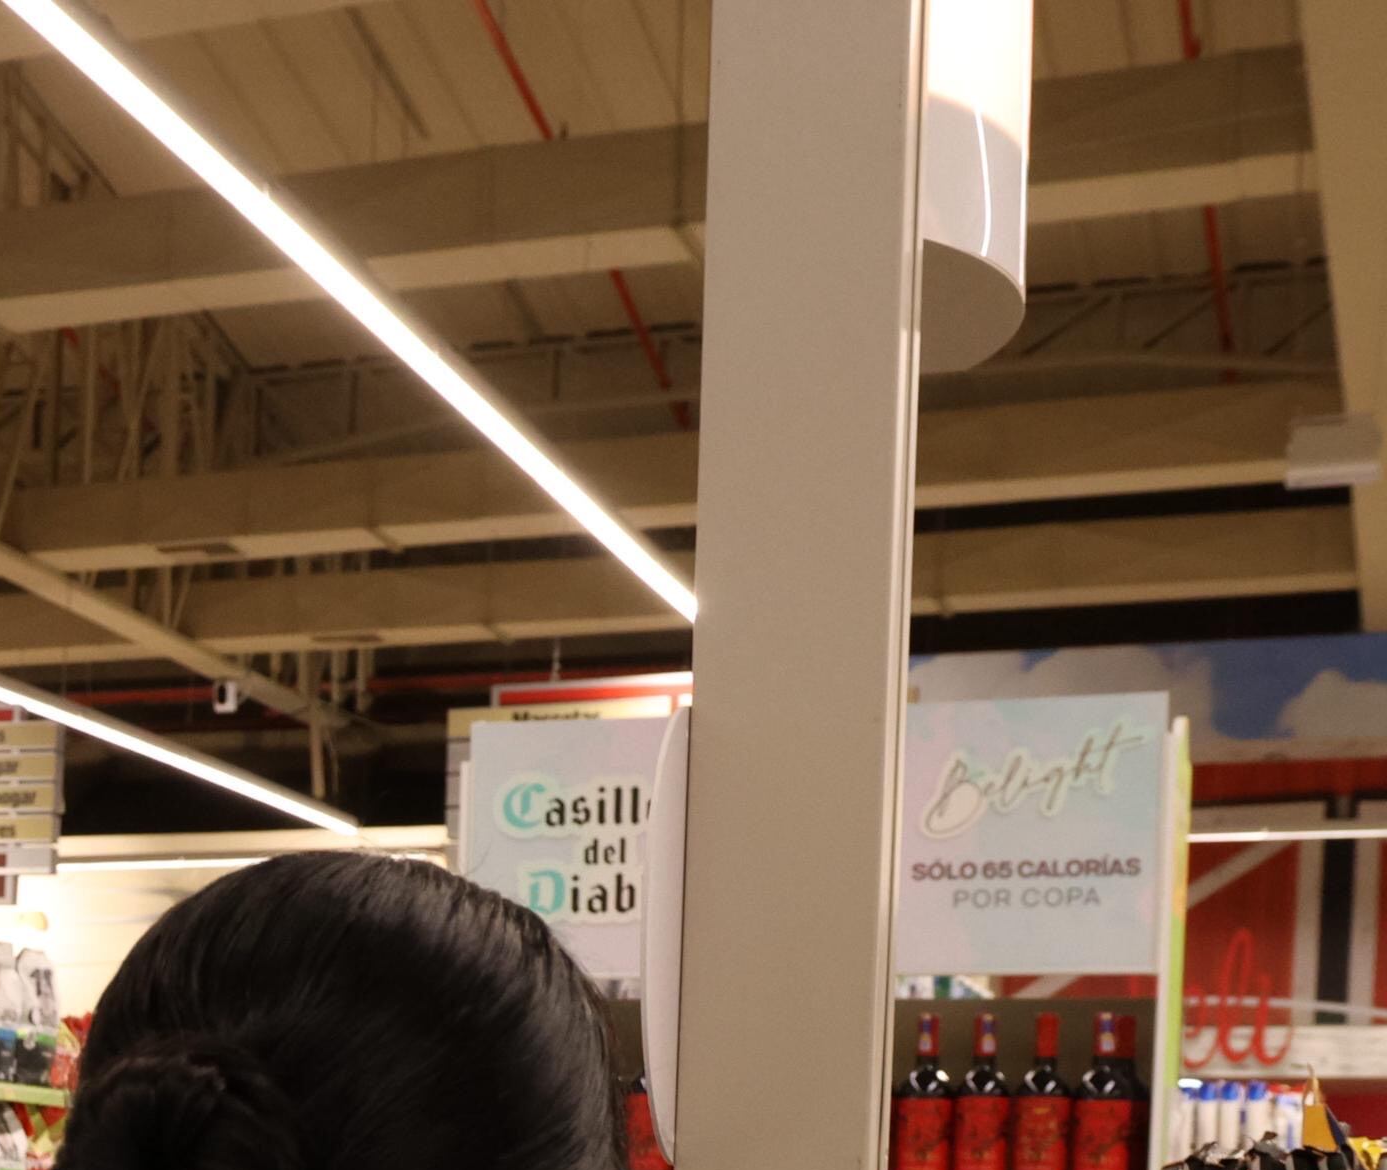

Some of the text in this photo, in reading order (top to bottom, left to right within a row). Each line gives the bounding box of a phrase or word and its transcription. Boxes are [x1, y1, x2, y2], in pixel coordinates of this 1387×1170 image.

[502, 782, 651, 830] Casill
[584, 837, 626, 865] del
[911, 854, 1142, 881] SÓLO 65 CALORÍAS
[526, 868, 636, 915] Diab
[952, 886, 1101, 909] POR COPA
